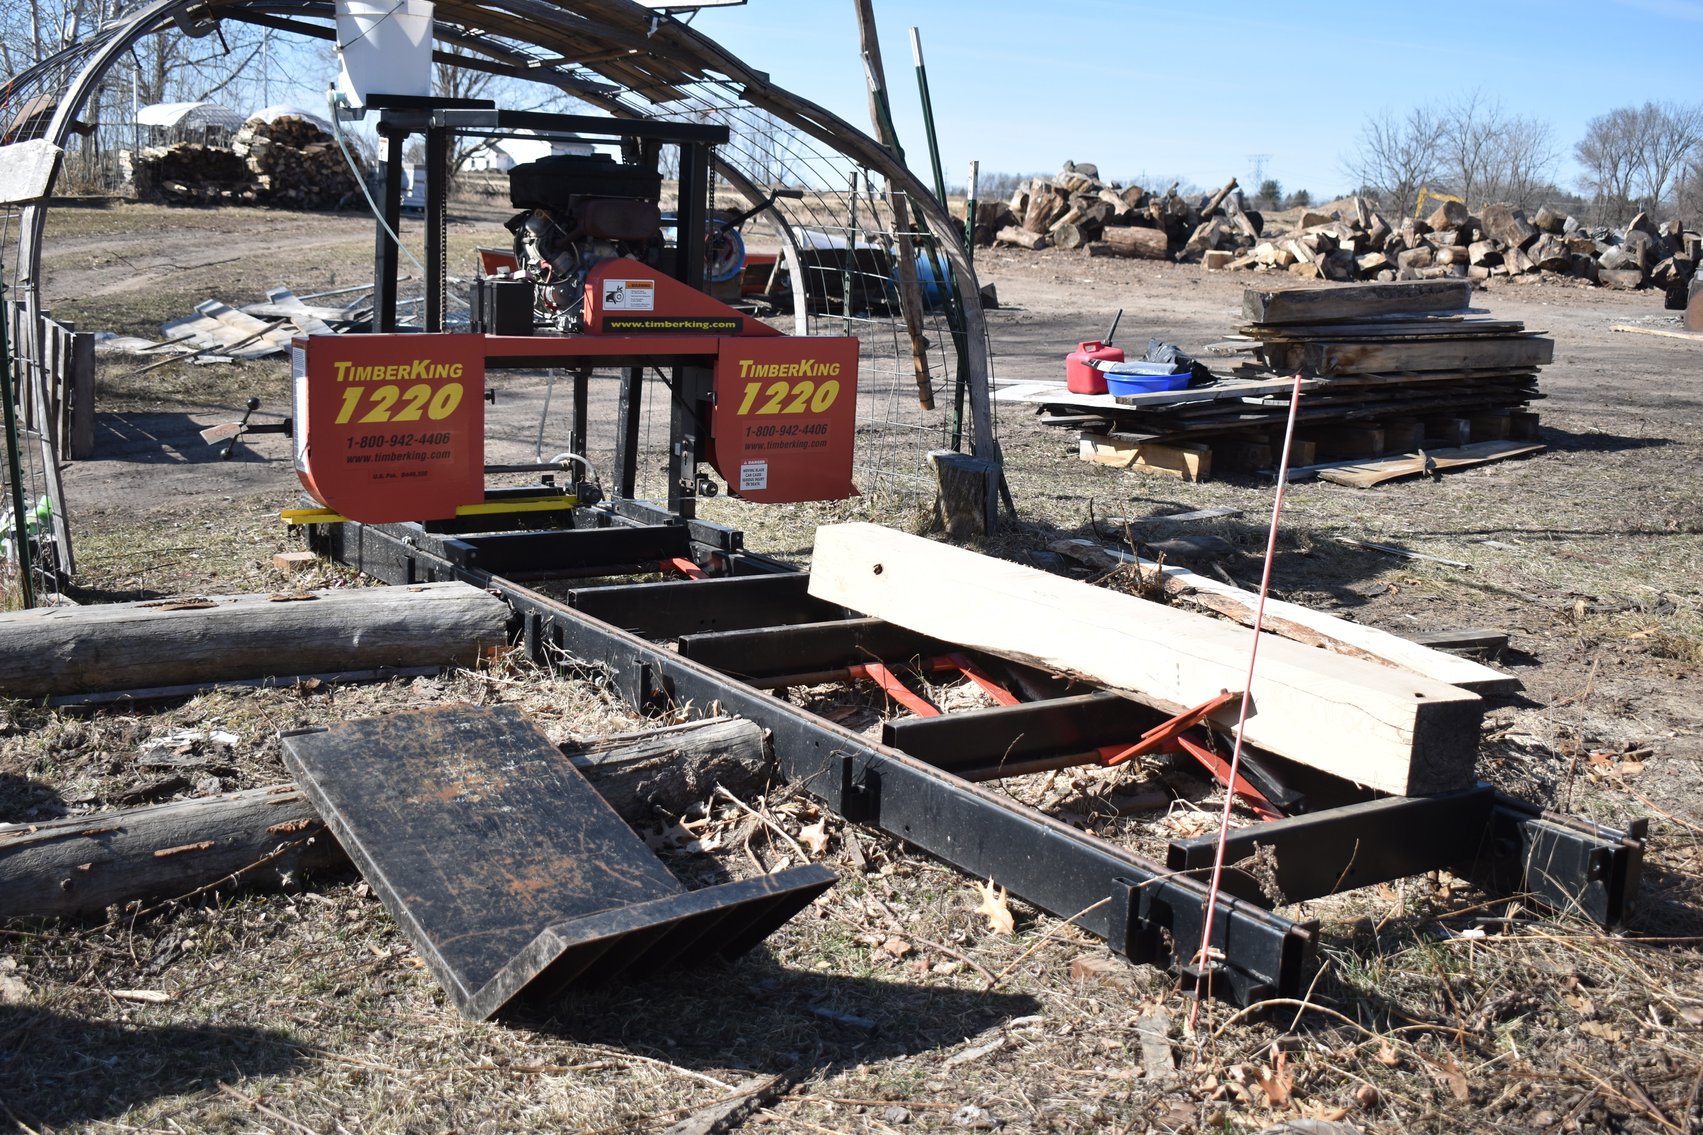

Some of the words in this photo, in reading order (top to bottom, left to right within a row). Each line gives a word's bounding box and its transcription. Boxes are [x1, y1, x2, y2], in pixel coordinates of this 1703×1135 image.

[611, 320, 736, 329] www.timberking.com
[335, 382, 464, 425] 1220
[737, 380, 840, 415] 1220
[745, 424, 828, 437] 1-800-942-4406
[346, 432, 450, 449] 1-800-942-4406
[744, 441, 828, 451] www.timberking.com
[346, 450, 451, 464] www.timberking.com
